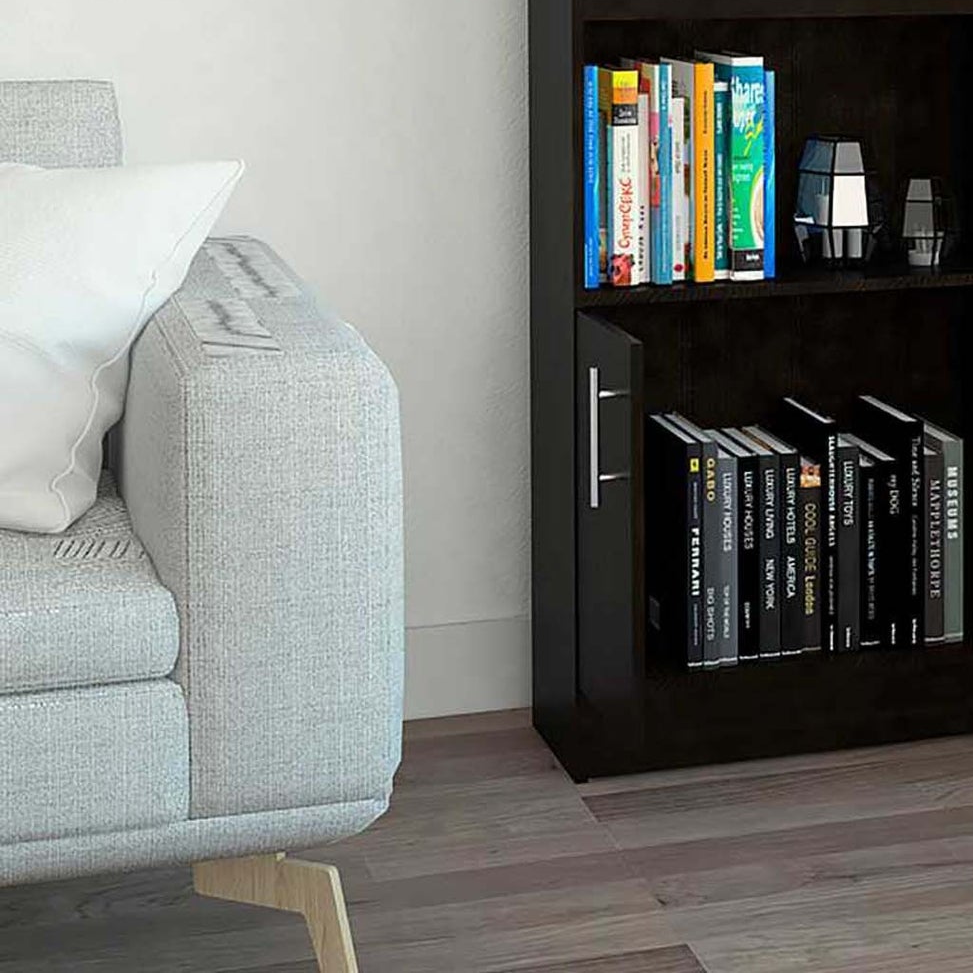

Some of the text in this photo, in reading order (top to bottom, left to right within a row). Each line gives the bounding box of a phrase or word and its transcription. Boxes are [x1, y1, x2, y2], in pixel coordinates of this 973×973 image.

[723, 472, 732, 512] LUXURY
[744, 471, 754, 550] LUXURY HOUSES
[804, 502, 817, 535] COOL
[844, 460, 854, 526] LUXURY TOYS
[889, 489, 899, 515] DOG
[947, 466, 959, 540] MUSEUMS
[691, 527, 700, 596] FERRARI
[723, 513, 732, 552] HOUSES
[765, 468, 775, 610] LUXURY LIVING NEW YORK
[786, 467, 796, 598] LUXURY HOTELS AMERICA
[804, 537, 817, 572] GUIDE
[929, 479, 941, 599] MAPPLETHORPE
